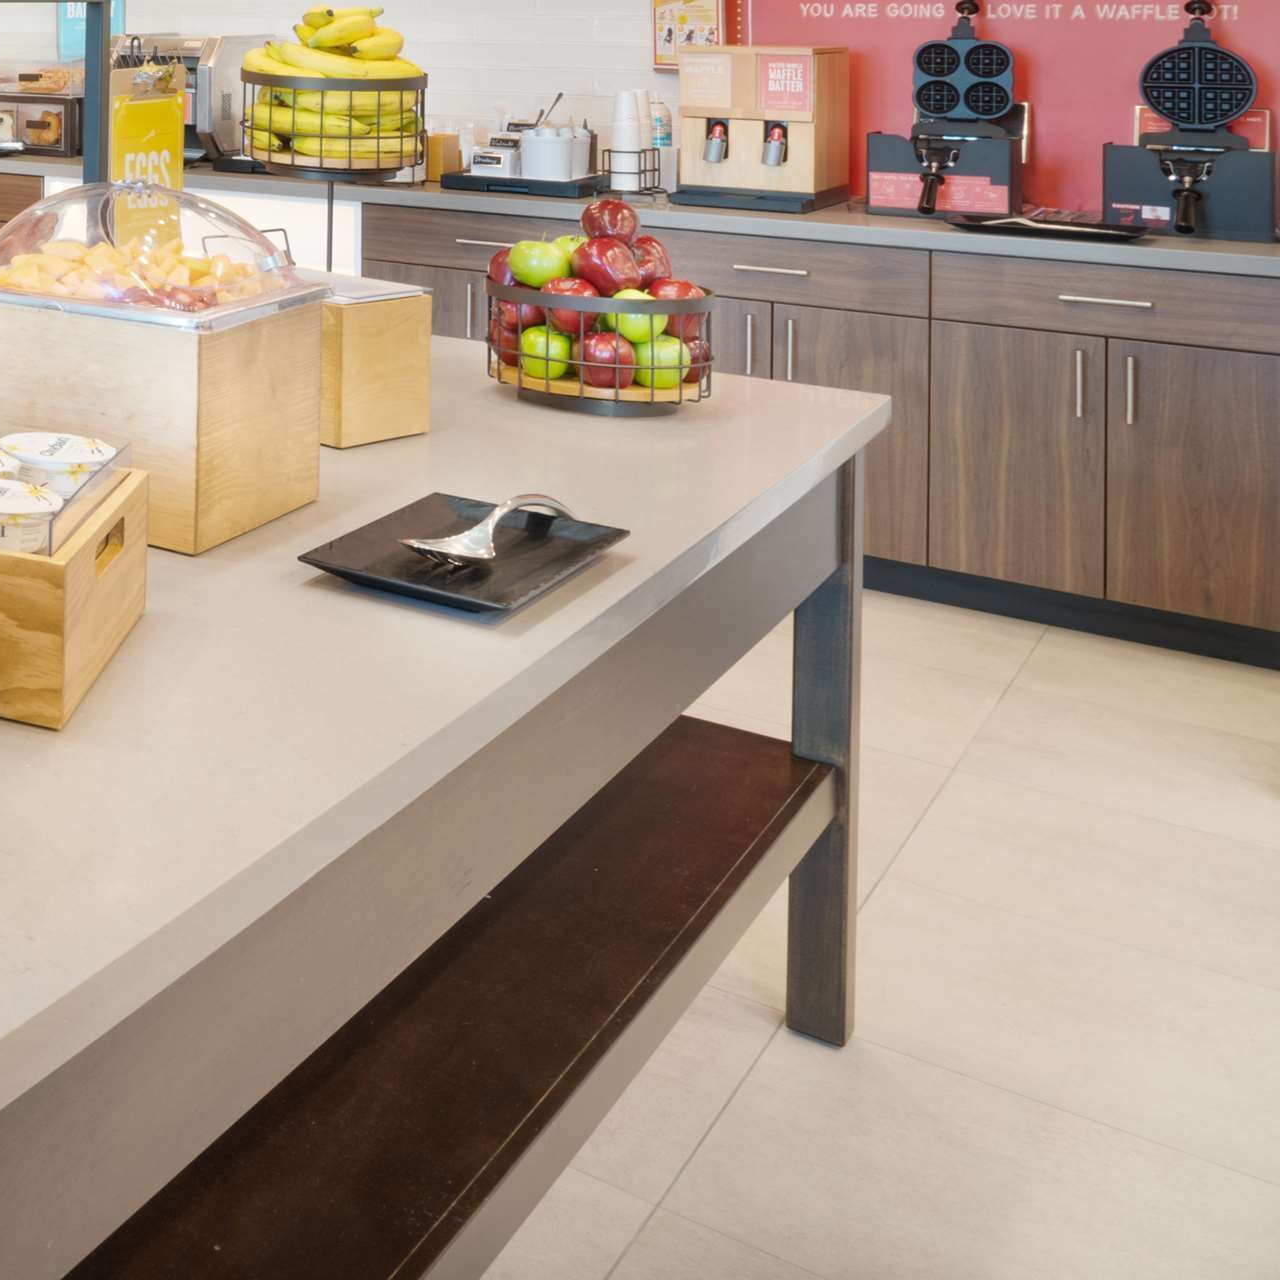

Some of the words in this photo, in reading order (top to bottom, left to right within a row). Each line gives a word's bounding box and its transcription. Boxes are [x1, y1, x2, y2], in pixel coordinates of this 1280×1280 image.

[800, 3, 835, 18] YOU
[842, 3, 879, 18] ARE
[886, 3, 945, 18] GOING
[987, 3, 1037, 19] LOVE
[1045, 4, 1063, 18] IT
[1071, 4, 1087, 18] A
[1095, 4, 1180, 20] WAFFLE
[768, 68, 804, 81] WAFFLE
[768, 79, 803, 92] BATTER
